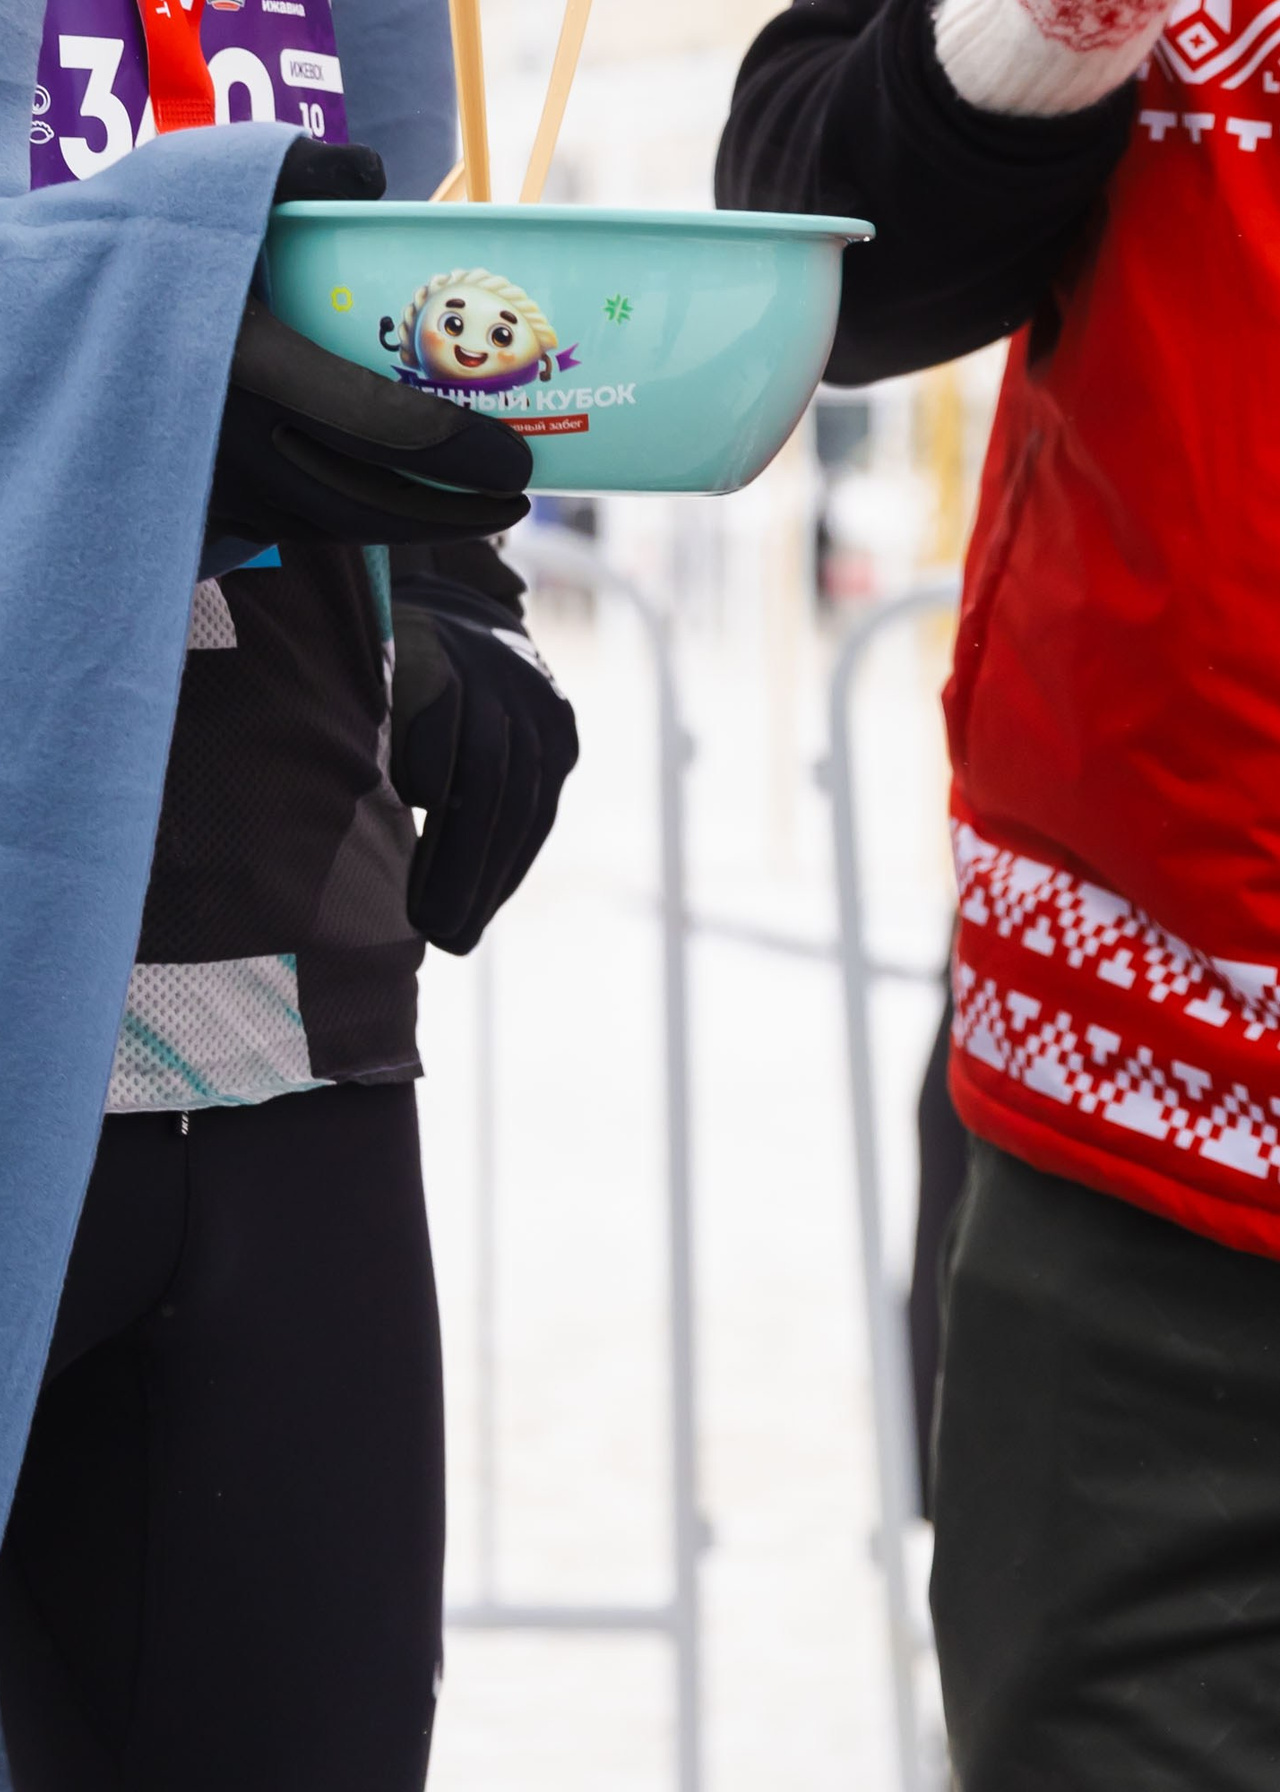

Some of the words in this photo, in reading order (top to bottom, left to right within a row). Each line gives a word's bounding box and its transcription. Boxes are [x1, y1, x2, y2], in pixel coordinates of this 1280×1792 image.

[58, 34, 276, 181] 30
[299, 102, 325, 138] 10
[535, 383, 637, 412] КУБОК
